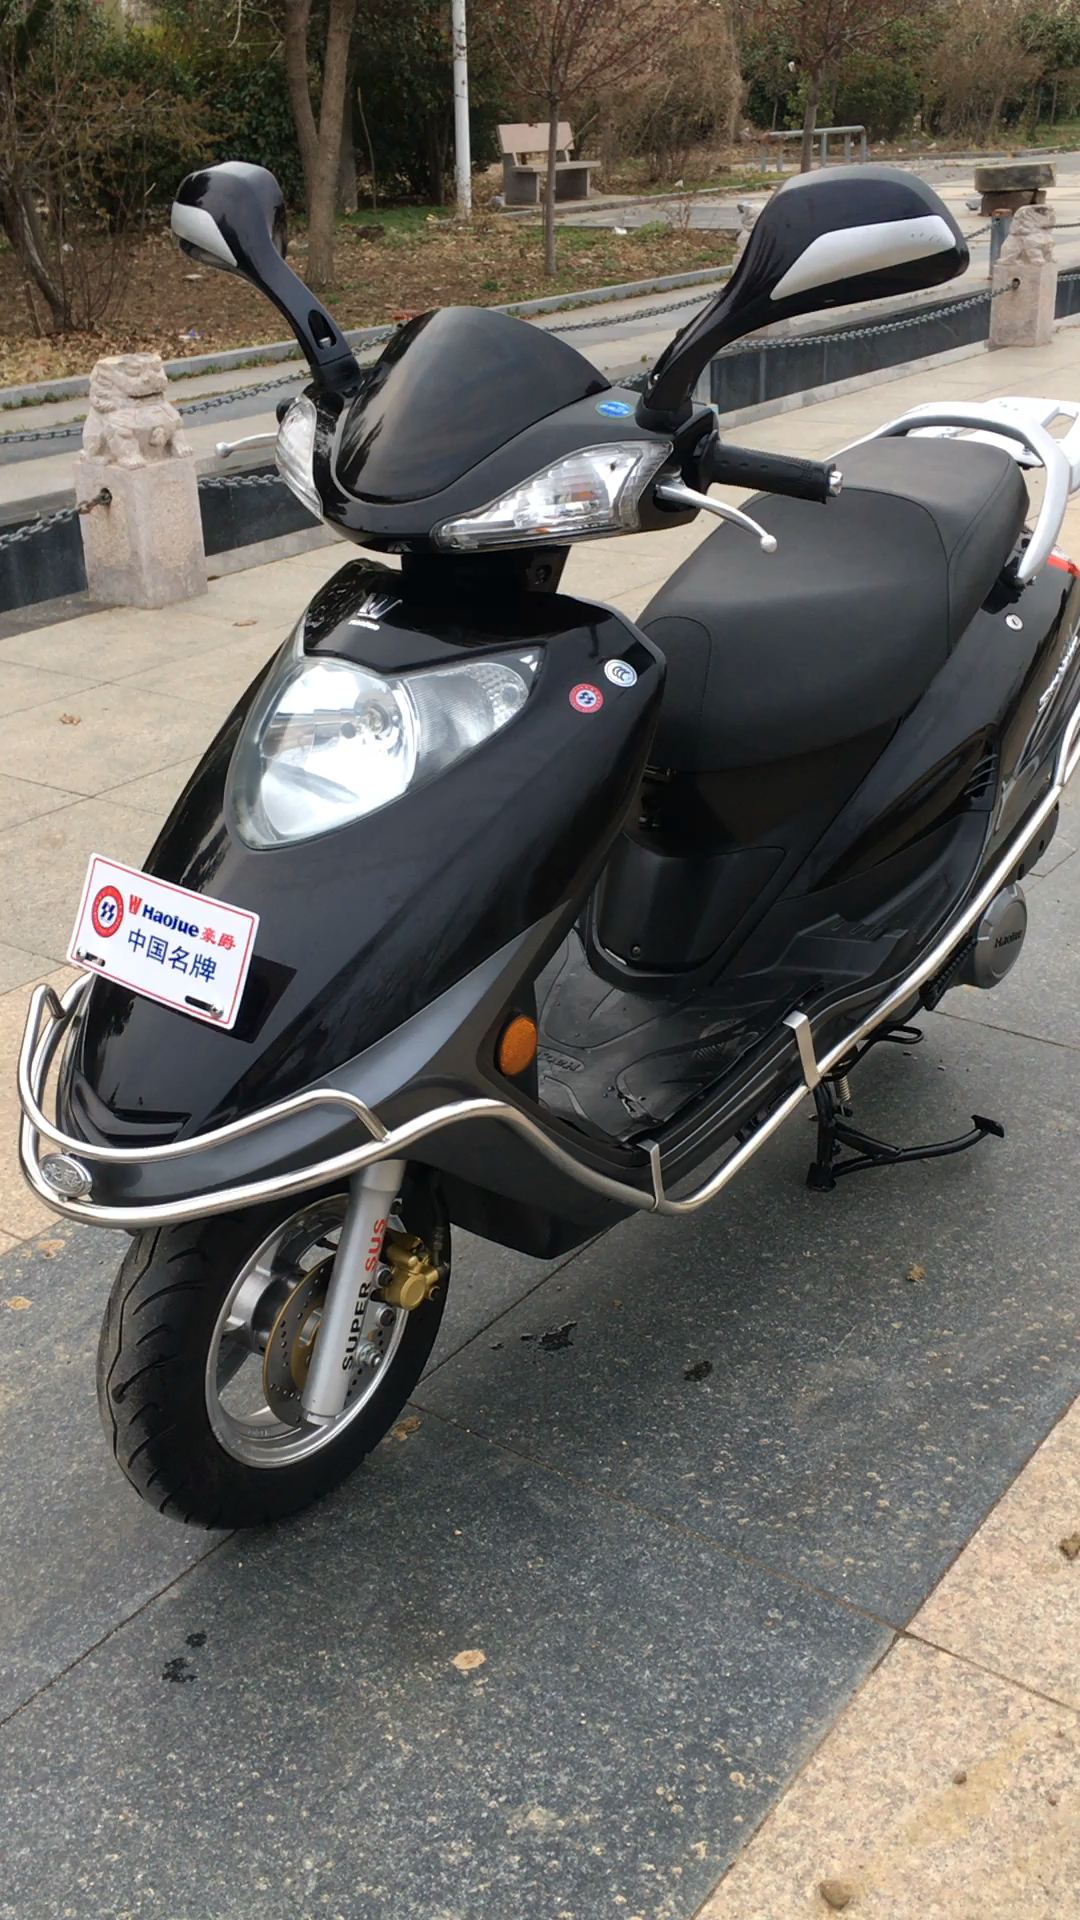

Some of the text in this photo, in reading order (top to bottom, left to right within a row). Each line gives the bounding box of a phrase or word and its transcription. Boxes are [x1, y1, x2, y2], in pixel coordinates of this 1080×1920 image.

[142, 904, 199, 937] Haojue
[128, 928, 217, 983] 中国名牌
[342, 1218, 386, 1371] SUPER SUS
